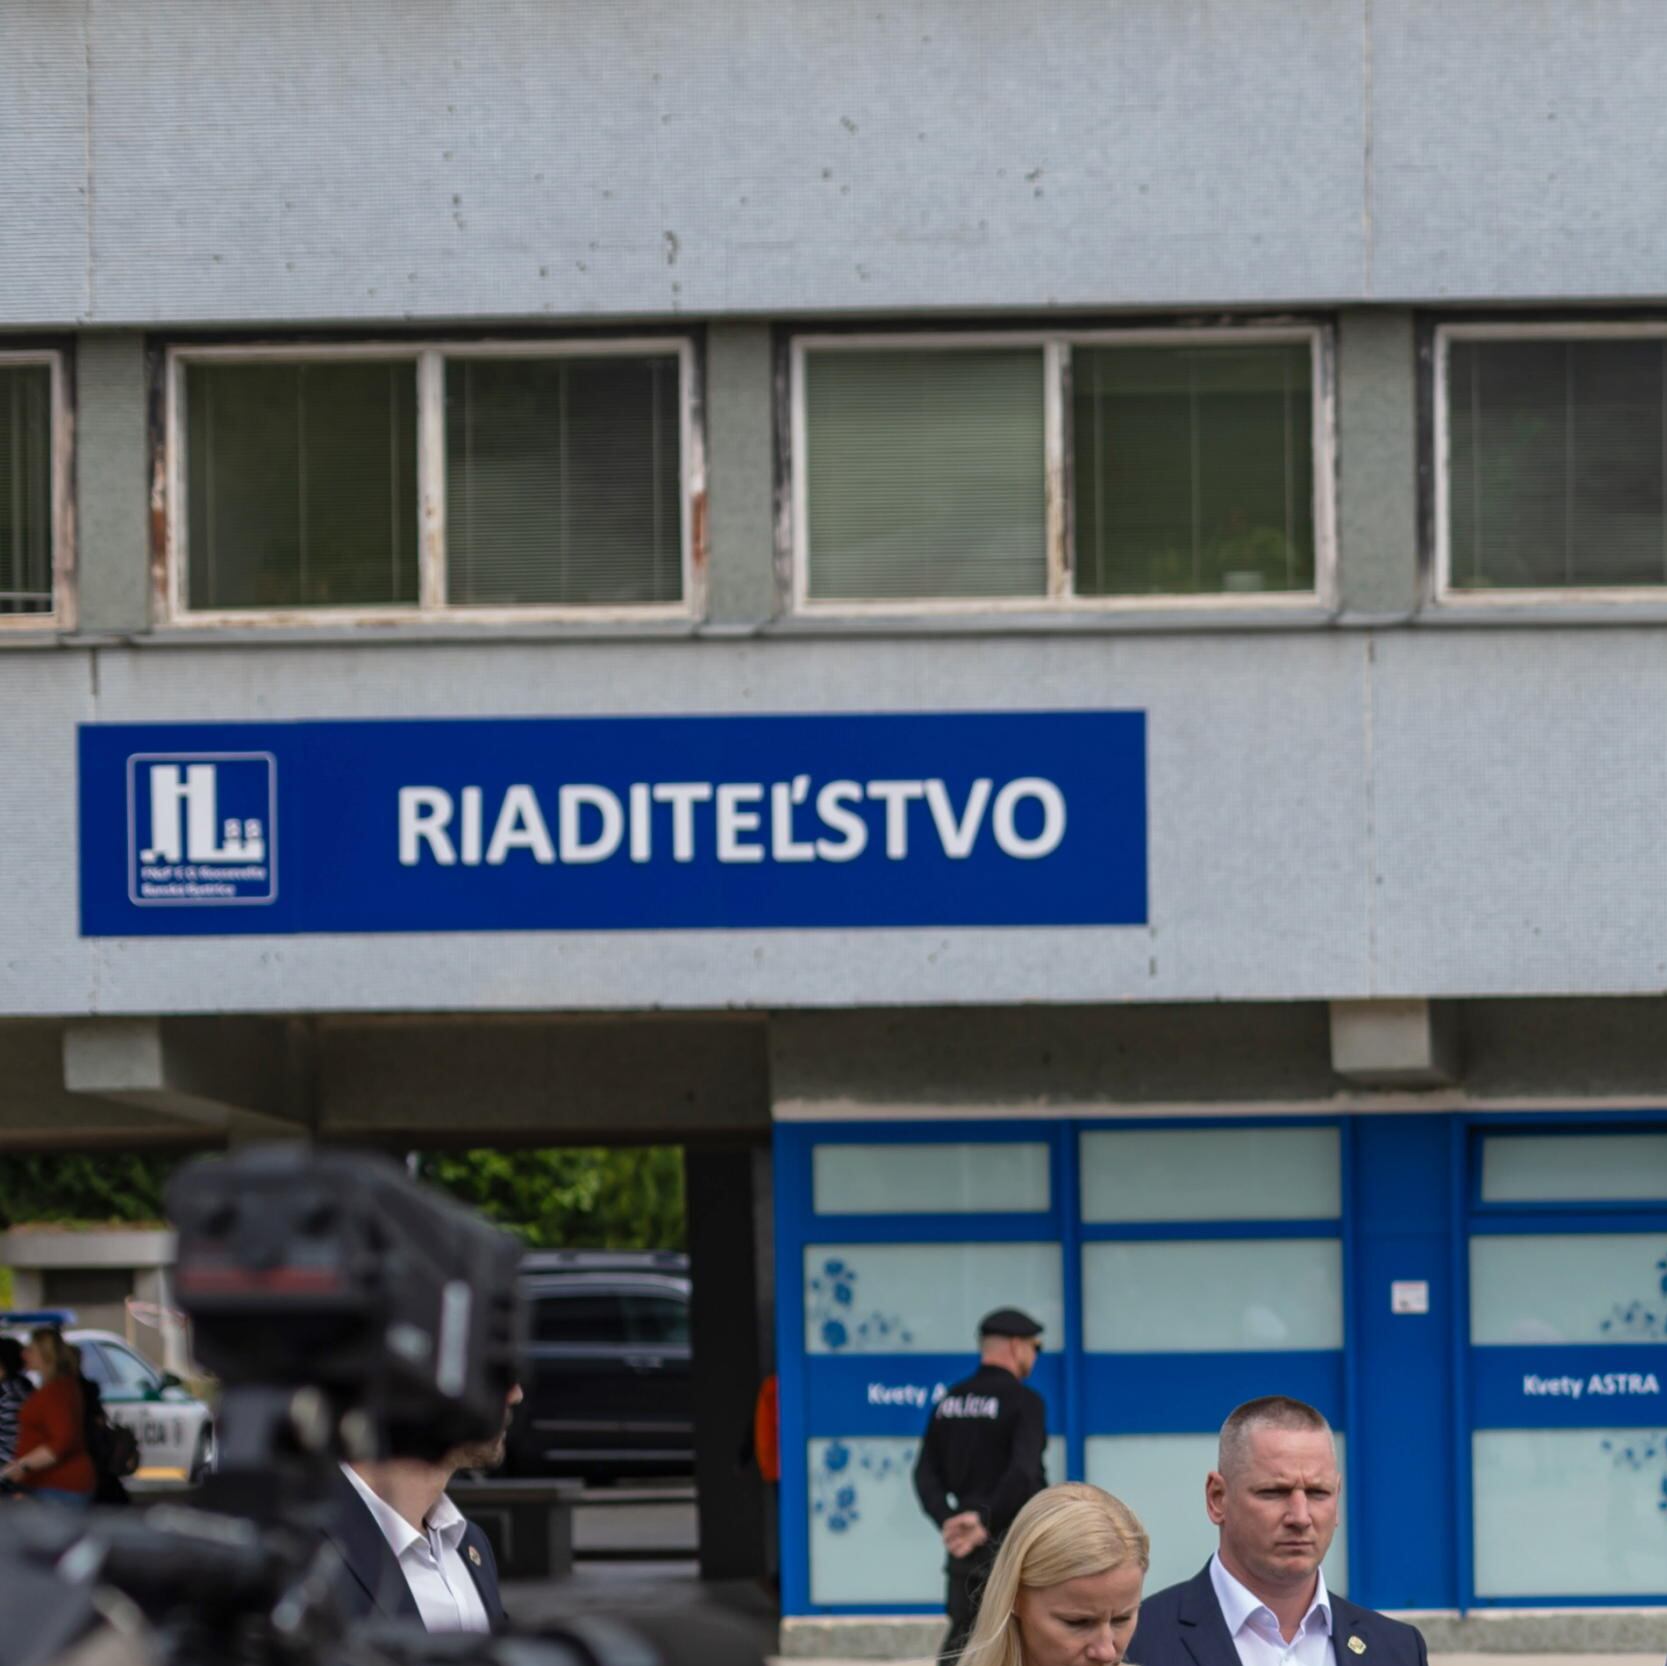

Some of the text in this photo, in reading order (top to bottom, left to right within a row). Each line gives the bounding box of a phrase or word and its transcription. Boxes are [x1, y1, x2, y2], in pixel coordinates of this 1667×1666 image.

[398, 775, 1068, 866] RIADITEĽSTVO
[867, 1382, 929, 1408] Kvety
[1523, 1373, 1660, 1399] Kvety ASTRA
